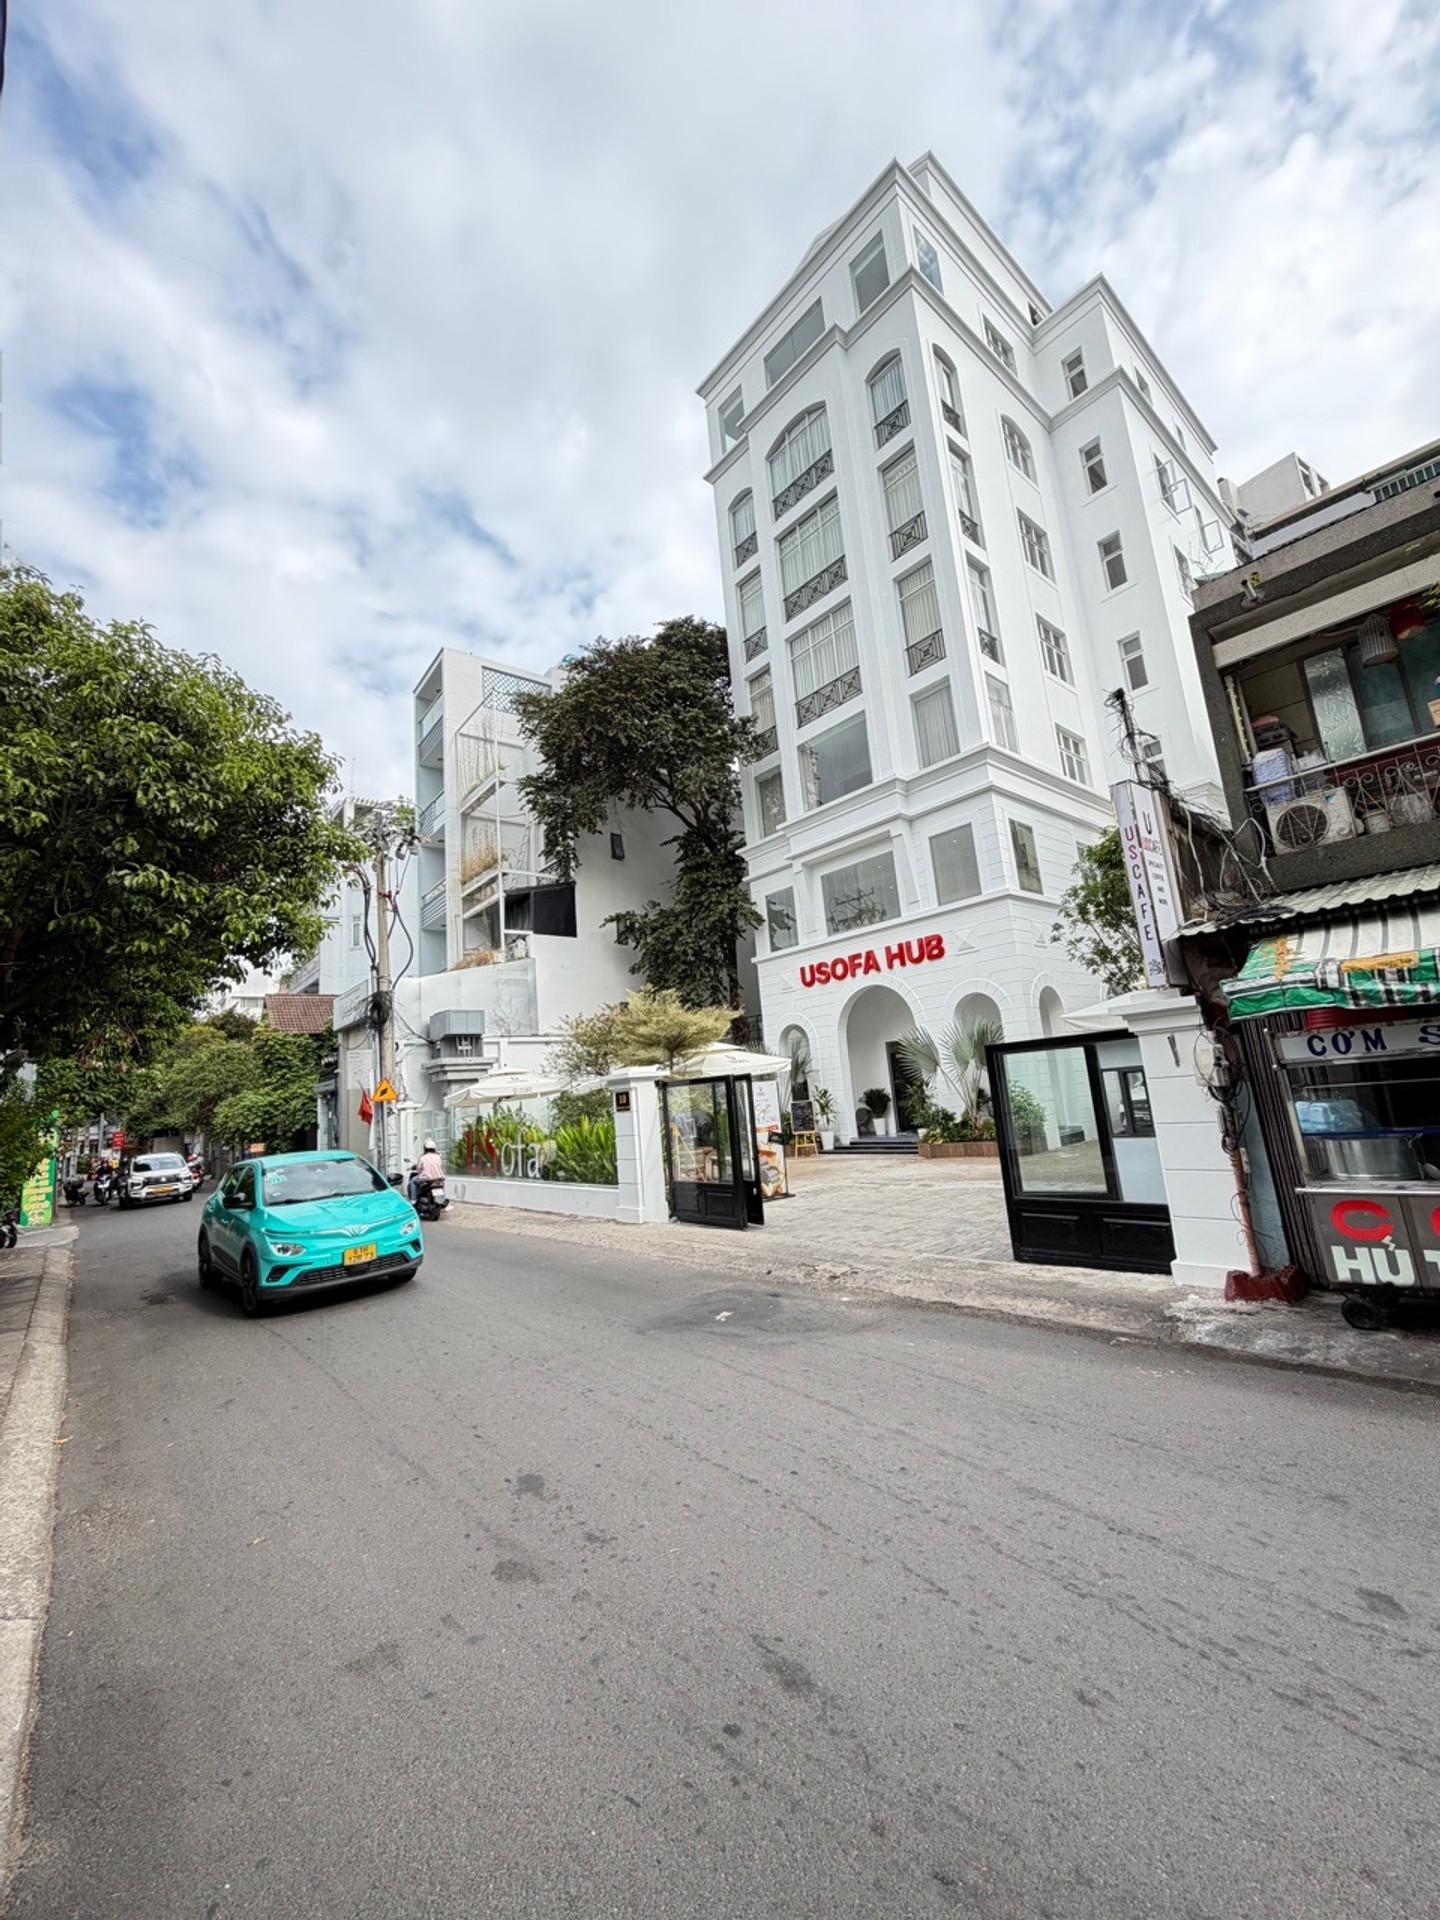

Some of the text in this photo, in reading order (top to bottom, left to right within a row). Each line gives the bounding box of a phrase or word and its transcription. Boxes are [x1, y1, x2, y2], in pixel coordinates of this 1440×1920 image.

[800, 934, 945, 988] USOFA HUB
[1307, 1028, 1387, 1056] CƠM
[1331, 1234, 1415, 1287] HỦ
